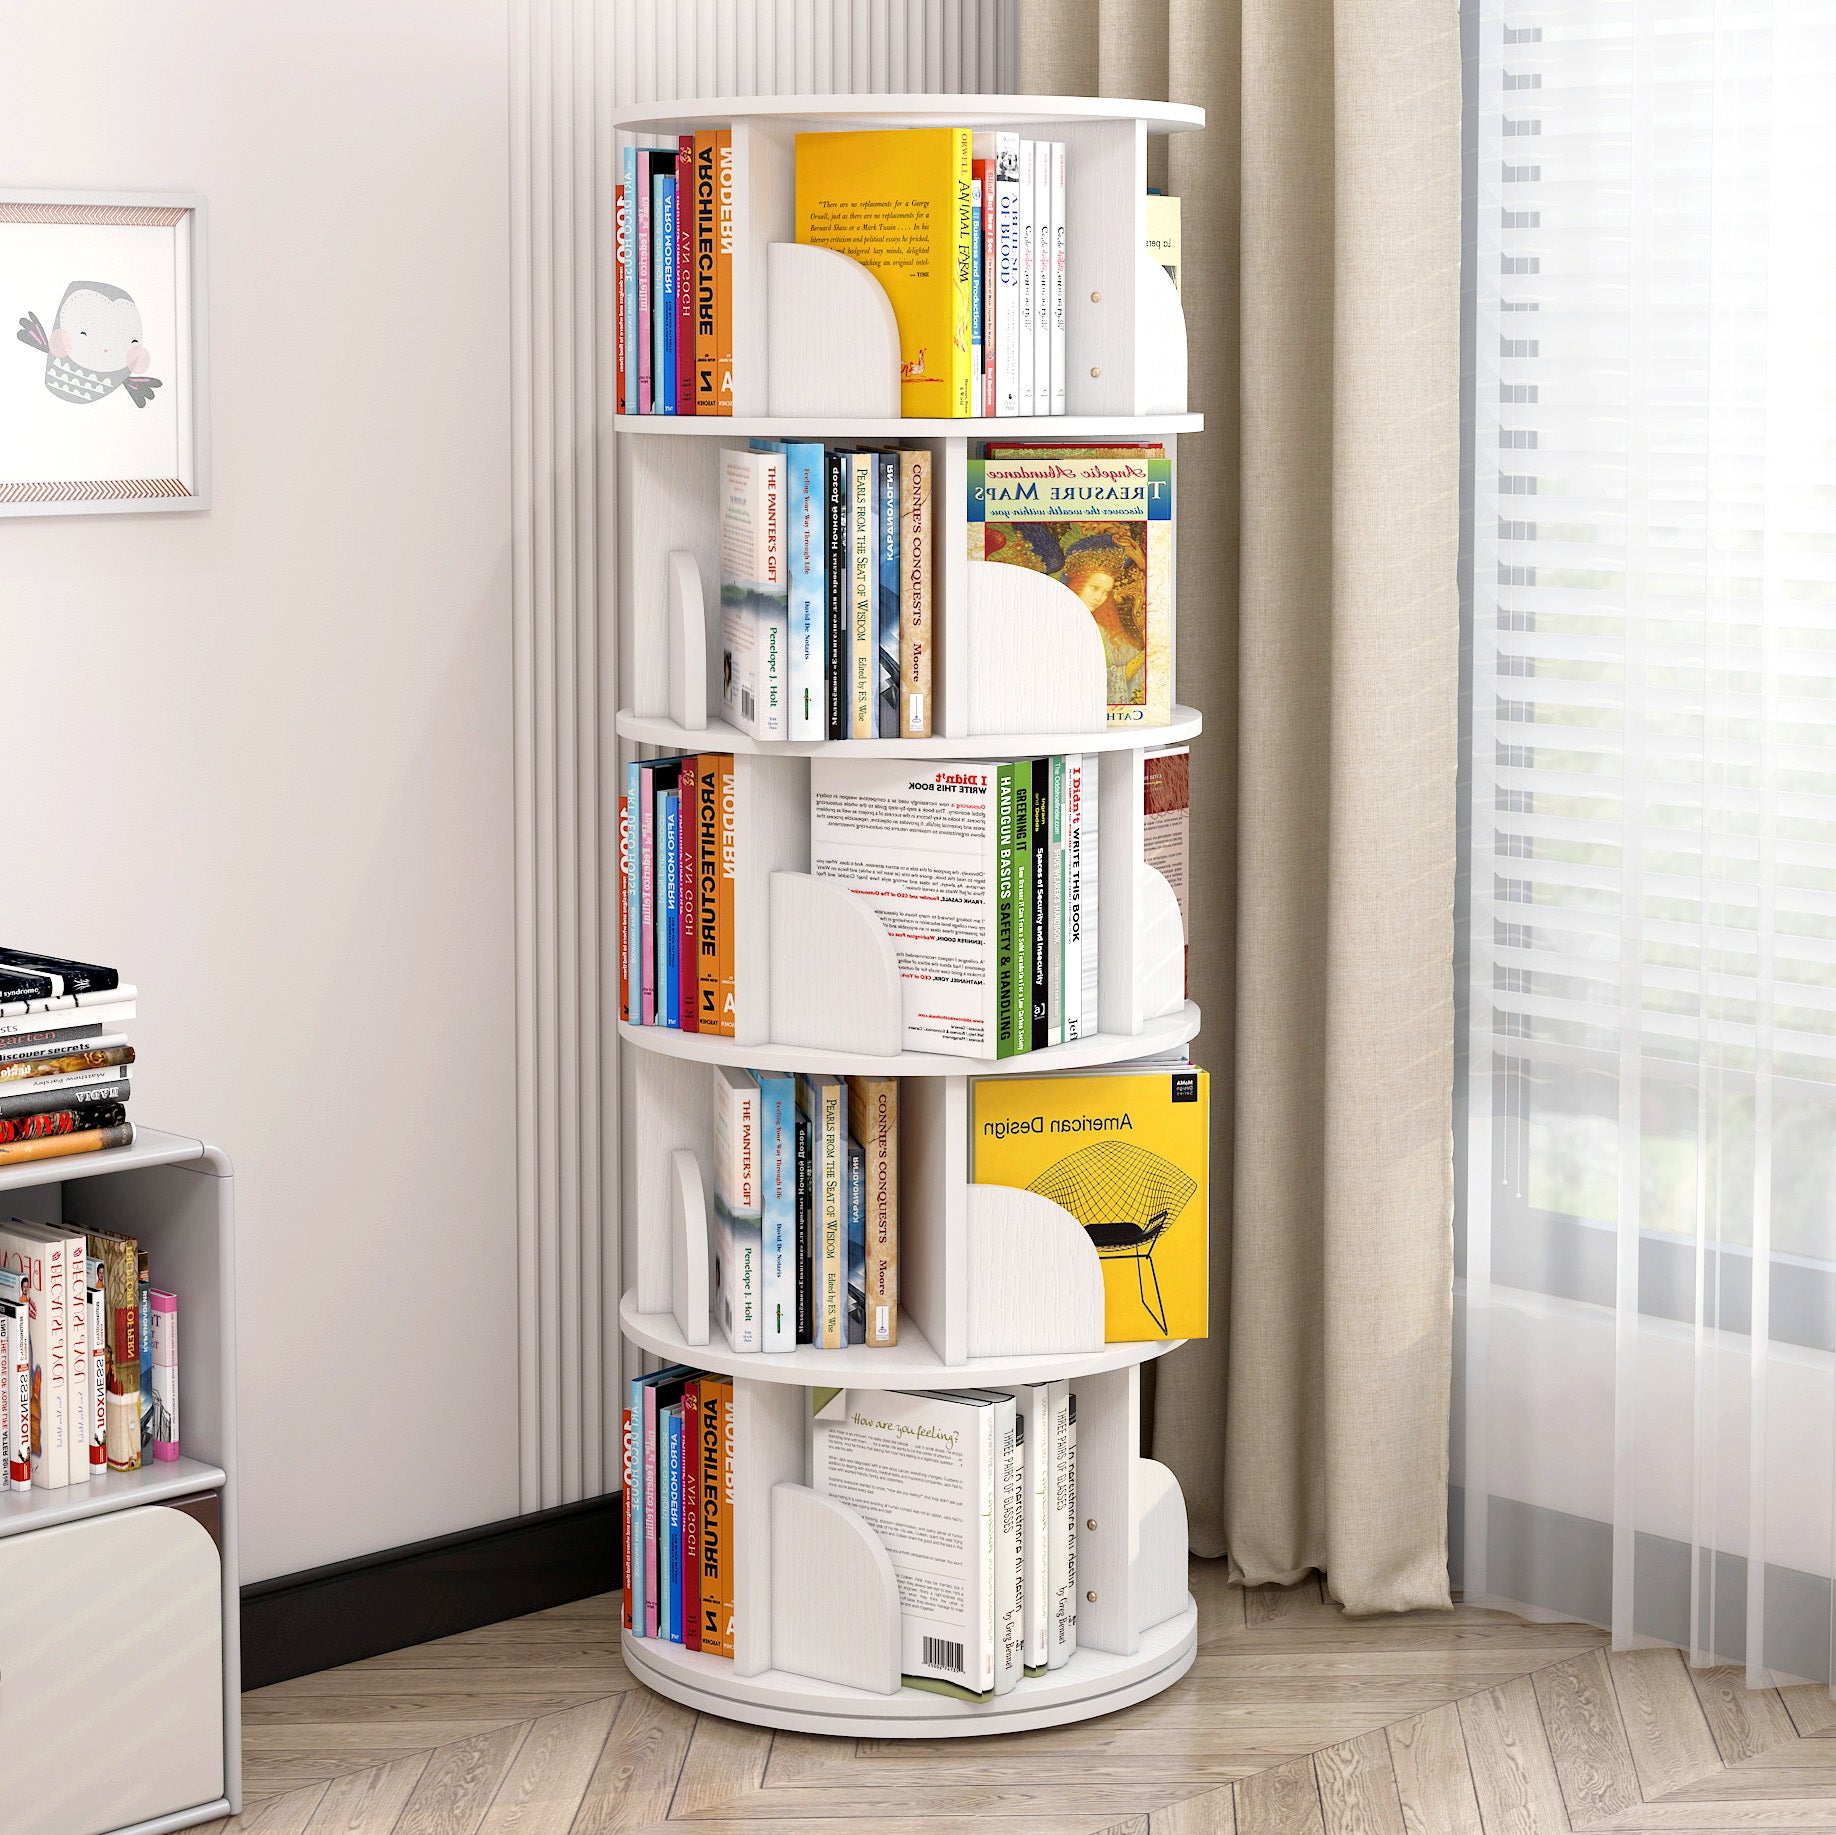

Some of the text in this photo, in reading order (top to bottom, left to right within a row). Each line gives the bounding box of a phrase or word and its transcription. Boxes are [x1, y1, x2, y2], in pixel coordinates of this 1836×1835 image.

[830, 213, 841, 221] just
[883, 212, 914, 220] replacements
[860, 201, 892, 210] replacements
[894, 200, 902, 210] for
[912, 200, 930, 208] George
[1012, 193, 1018, 203] A
[958, 180, 970, 282] ANIMAL FARM
[1001, 196, 1010, 284] OF BLOOD
[768, 467, 777, 583] THE PAINTER'S GIFT
[856, 469, 868, 641] PEARLS FROM THE SEAT OF WISDOM
[912, 464, 922, 682] CONNIE'S CONQUESTS Moore
[768, 627, 778, 672] Penelope
[804, 621, 811, 632] De
[857, 657, 866, 679] Edited
[857, 681, 866, 689] by
[768, 686, 778, 707] Holt
[857, 706, 866, 722] Wise
[1016, 789, 1027, 851] GREENING IT
[1000, 776, 1011, 1040] HANDGUN BASICS SAFETY & HANDLING
[1036, 848, 1044, 985] Spaces of Security and Insecurity
[48, 1044, 90, 1054] secrets
[742, 1099, 751, 1206] THE PAINTER'S GIFT
[878, 1094, 887, 1295] CONNIE'S CONQUESTS Moore
[852, 1413, 959, 1450] How are you feeling?
[1004, 1431, 1013, 1534] THREE PAIRS OF GLASSES
